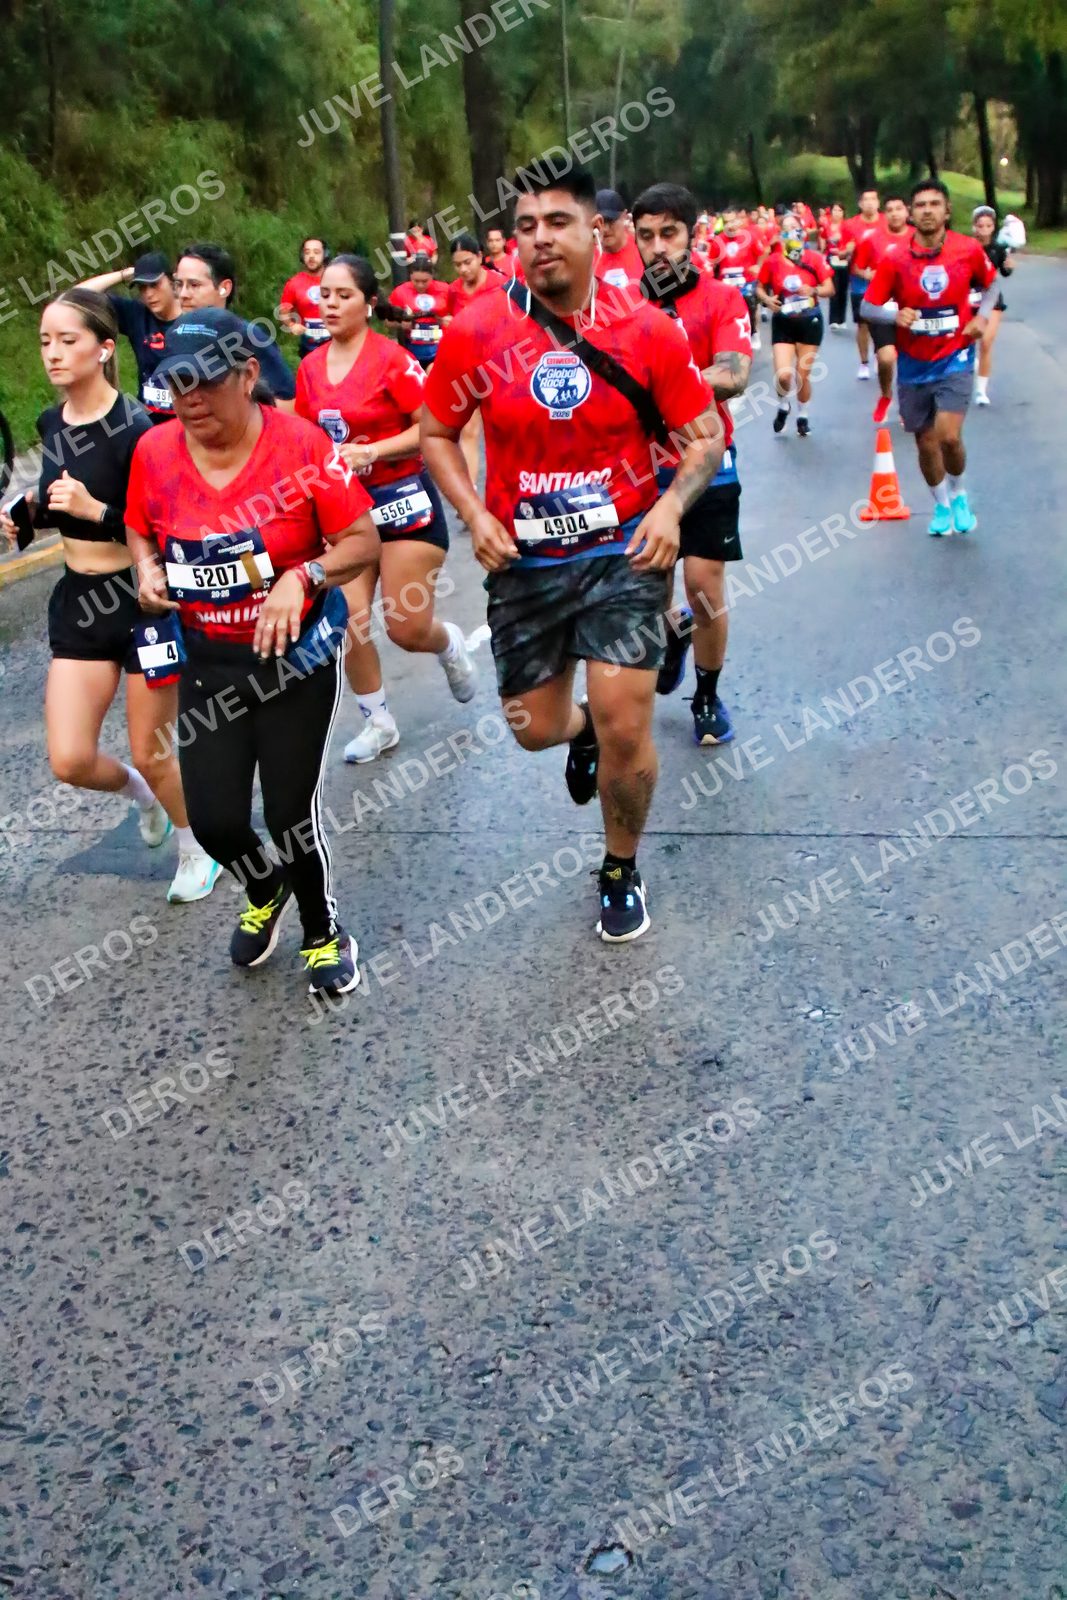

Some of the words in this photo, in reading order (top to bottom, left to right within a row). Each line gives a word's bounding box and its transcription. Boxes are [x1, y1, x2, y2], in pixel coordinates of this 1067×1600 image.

[539, 377, 566, 388] Race
[546, 367, 578, 379] Global
[380, 498, 413, 522] 5564
[543, 513, 589, 537] 4904
[192, 563, 238, 588] 5207
[166, 643, 177, 661] 4
